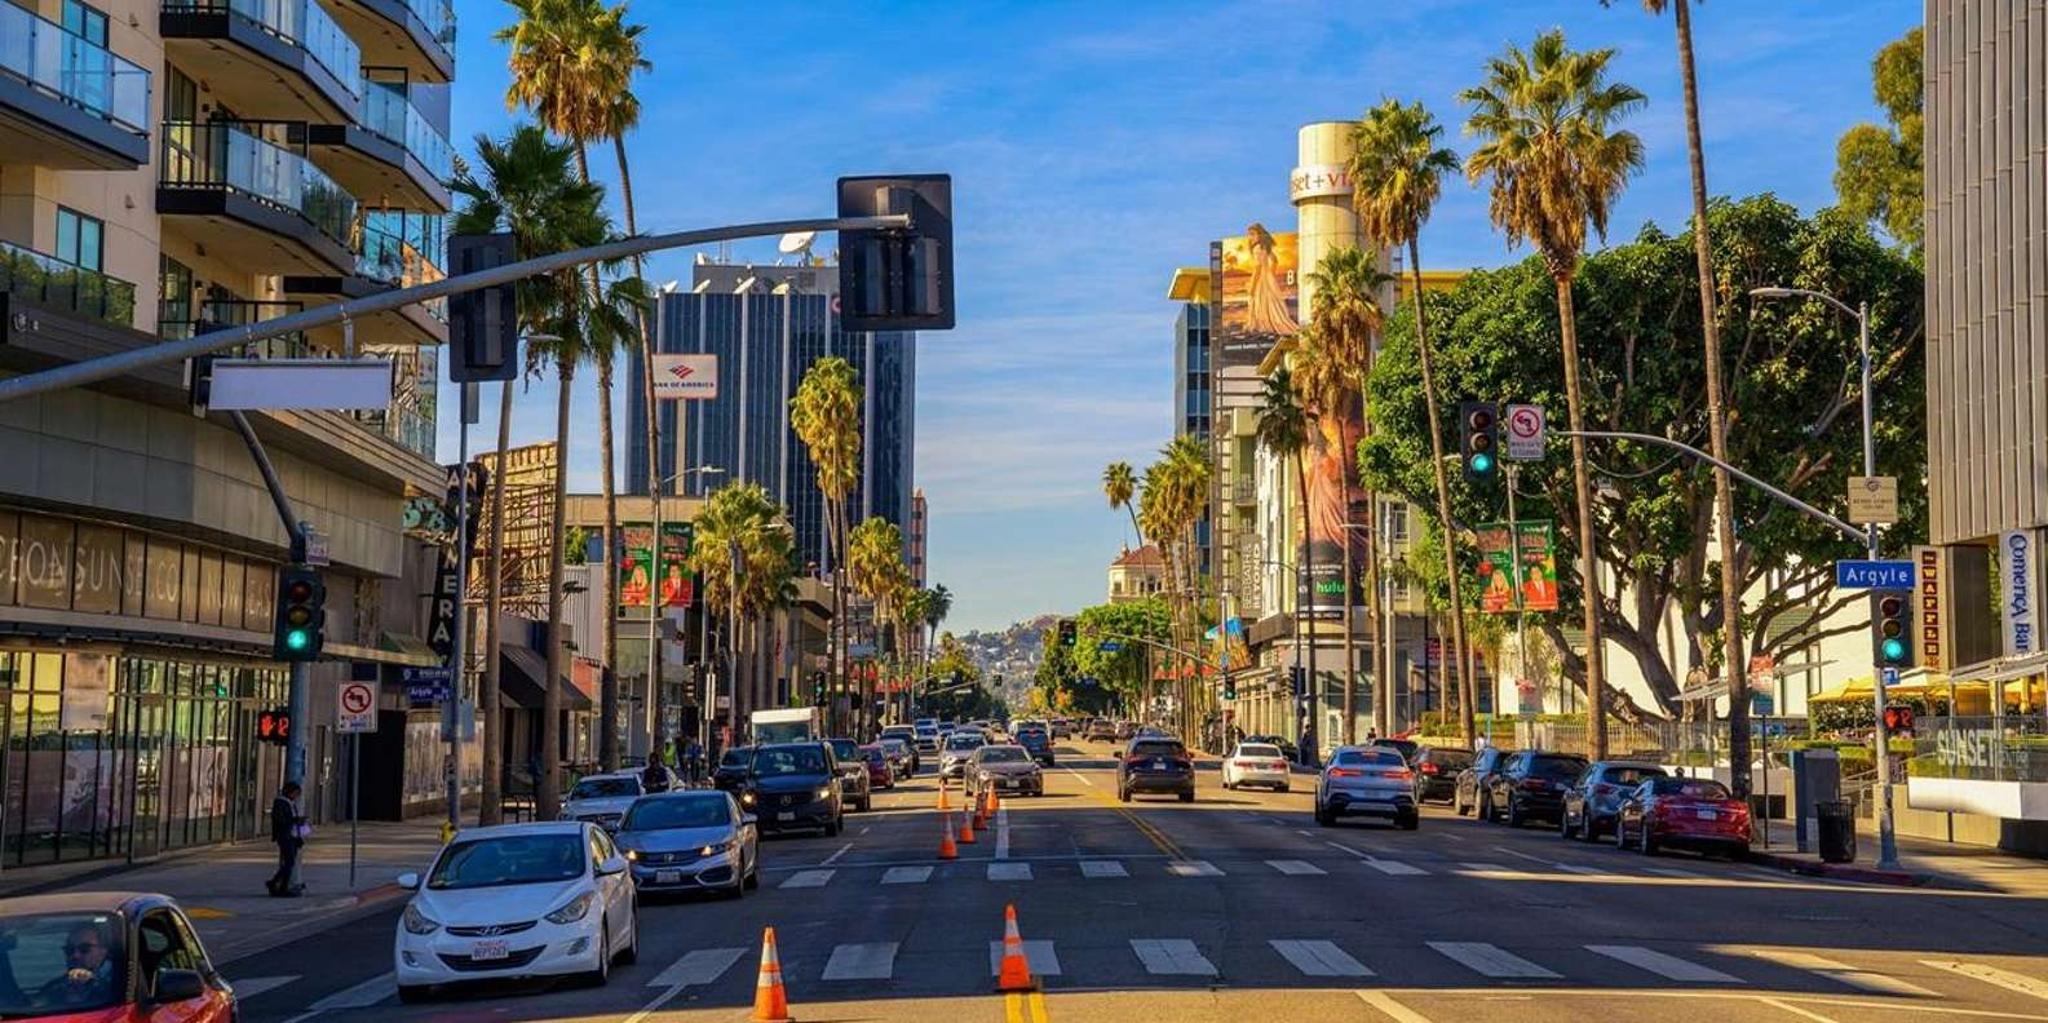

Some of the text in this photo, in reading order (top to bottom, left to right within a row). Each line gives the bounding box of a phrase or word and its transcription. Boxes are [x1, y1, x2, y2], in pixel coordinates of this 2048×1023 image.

[1316, 581, 1346, 593] hulu
[1846, 567, 1908, 586] Argyle
[1923, 567, 1937, 654] WAFFLE
[1937, 730, 1996, 767] SUNSET
